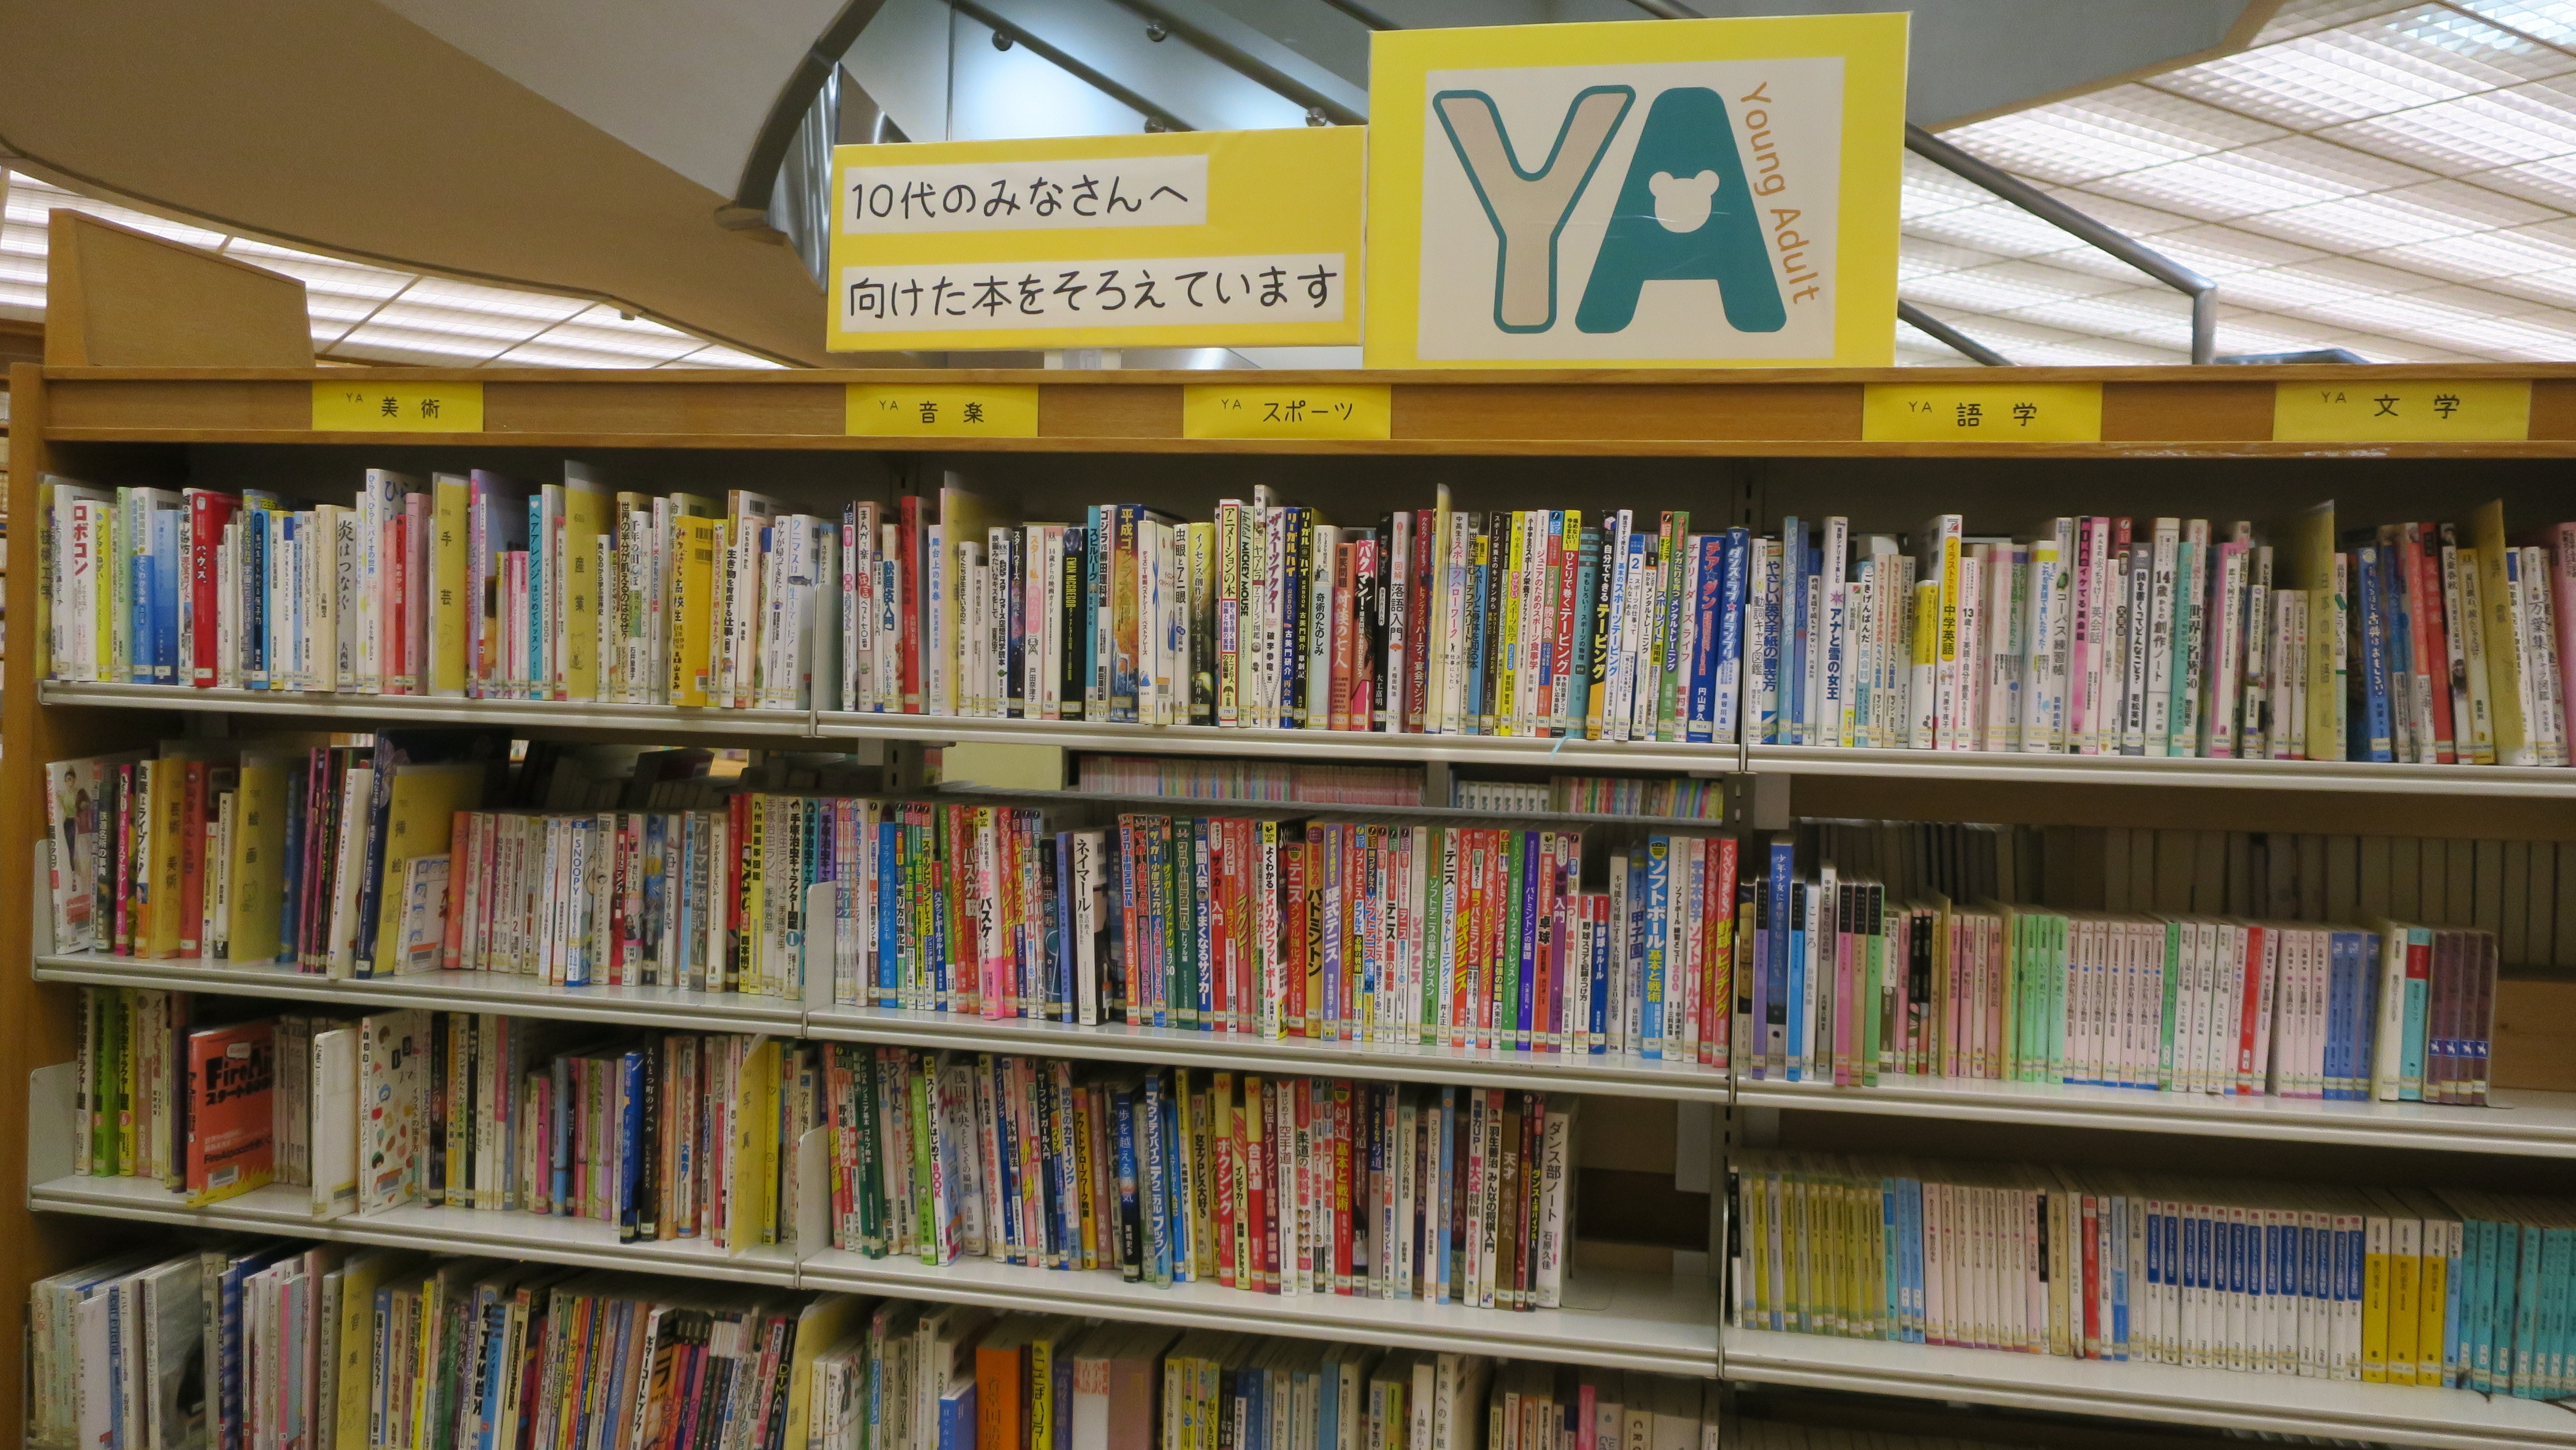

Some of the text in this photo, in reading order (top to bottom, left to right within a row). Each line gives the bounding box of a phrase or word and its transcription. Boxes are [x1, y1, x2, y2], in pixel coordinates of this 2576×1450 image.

[852, 175, 1188, 219] 10代のみなさんへ
[1433, 84, 1787, 333] YA
[1740, 81, 1820, 305] Young Adult
[850, 264, 1337, 319] 向けた本をそろえています
[346, 393, 440, 419] YA 美術
[879, 400, 984, 424] YA 音楽
[1221, 399, 1353, 423] YA スポーツ
[1908, 402, 2037, 427] YA 語学
[2321, 392, 2460, 419] YA 文学
[73, 506, 89, 576] ロボコン
[338, 519, 354, 610] 炎はつなぐ
[531, 514, 540, 579] ヘアアレンジ
[620, 502, 630, 642] 世界の半分が飢えるのはなぜ?
[630, 520, 640, 585] 千年の田んぼ
[774, 520, 786, 596] サケが帰ってきた!
[790, 519, 801, 572] クニマスは
[932, 537, 941, 601] 舞台上の青春
[1089, 528, 1098, 581] スピルバーグ
[1175, 528, 1186, 604] 虫眼とアニ眼
[1223, 507, 1236, 596] アニメーションの本
[1241, 542, 1251, 577] MICKEY
[1338, 547, 1348, 588] 爆笑問題
[1631, 557, 1639, 570] 2
[1066, 557, 1076, 608] EWAN MCGREGOR
[1240, 578, 1250, 617] MOUSE
[1390, 584, 1405, 641] 落語入門
[1555, 551, 1575, 672] ひとりで巻くテーピング
[1314, 592, 1325, 655] 奇術のたのしみ
[1751, 596, 1764, 676] 動詞キャラ図鑑
[1827, 608, 1842, 701] アナと雪の女王
[1028, 667, 1036, 702] 戸田奈津子
[1697, 688, 1707, 721] 円山夢久
[572, 839, 582, 895] SNOOPY
[788, 813, 800, 930] 手塚治虫キャラクター図鑑
[1076, 838, 1092, 913] ネイマール
[1288, 862, 1302, 903] テニス
[1444, 850, 1457, 885] テニス
[1043, 874, 1053, 927] 中田英寿
[1195, 839, 1210, 1006] 風間八宏 うまくなるサッカー
[1265, 846, 1276, 999] よくわかるアメリカンフットボール
[1324, 887, 1340, 963] 硬式テニス
[1386, 902, 1396, 940] テニス
[1522, 886, 1535, 960] バドミントンの基礎
[1538, 916, 1551, 944] 卓球
[1613, 875, 1623, 943] 不可能を可能にする
[1646, 860, 1668, 1003] ソフトボール 基本と戦術
[1807, 905, 1817, 949] こころ
[1307, 889, 1322, 977] バドミントン
[1579, 922, 1591, 1002] 野球スコアと記録のつけ方
[1594, 926, 1606, 981] 野球のルール
[1630, 910, 1645, 959] 甲子園
[645, 1047, 655, 1133] えんとつ町のプペル
[954, 1070, 970, 1127] 浅田真央
[1279, 1092, 1292, 1165] はじめての空手道
[1334, 1106, 1351, 1212] 剣道 基本と戦術
[932, 1162, 942, 1199] BOOK
[1217, 1140, 1232, 1216] ボクシング
[1484, 1126, 1499, 1254] 羽生善治 みんなの将棋入門
[1545, 1121, 1564, 1222] ダンス部ノート
[1435, 1364, 1449, 1449] 未来への手紙
